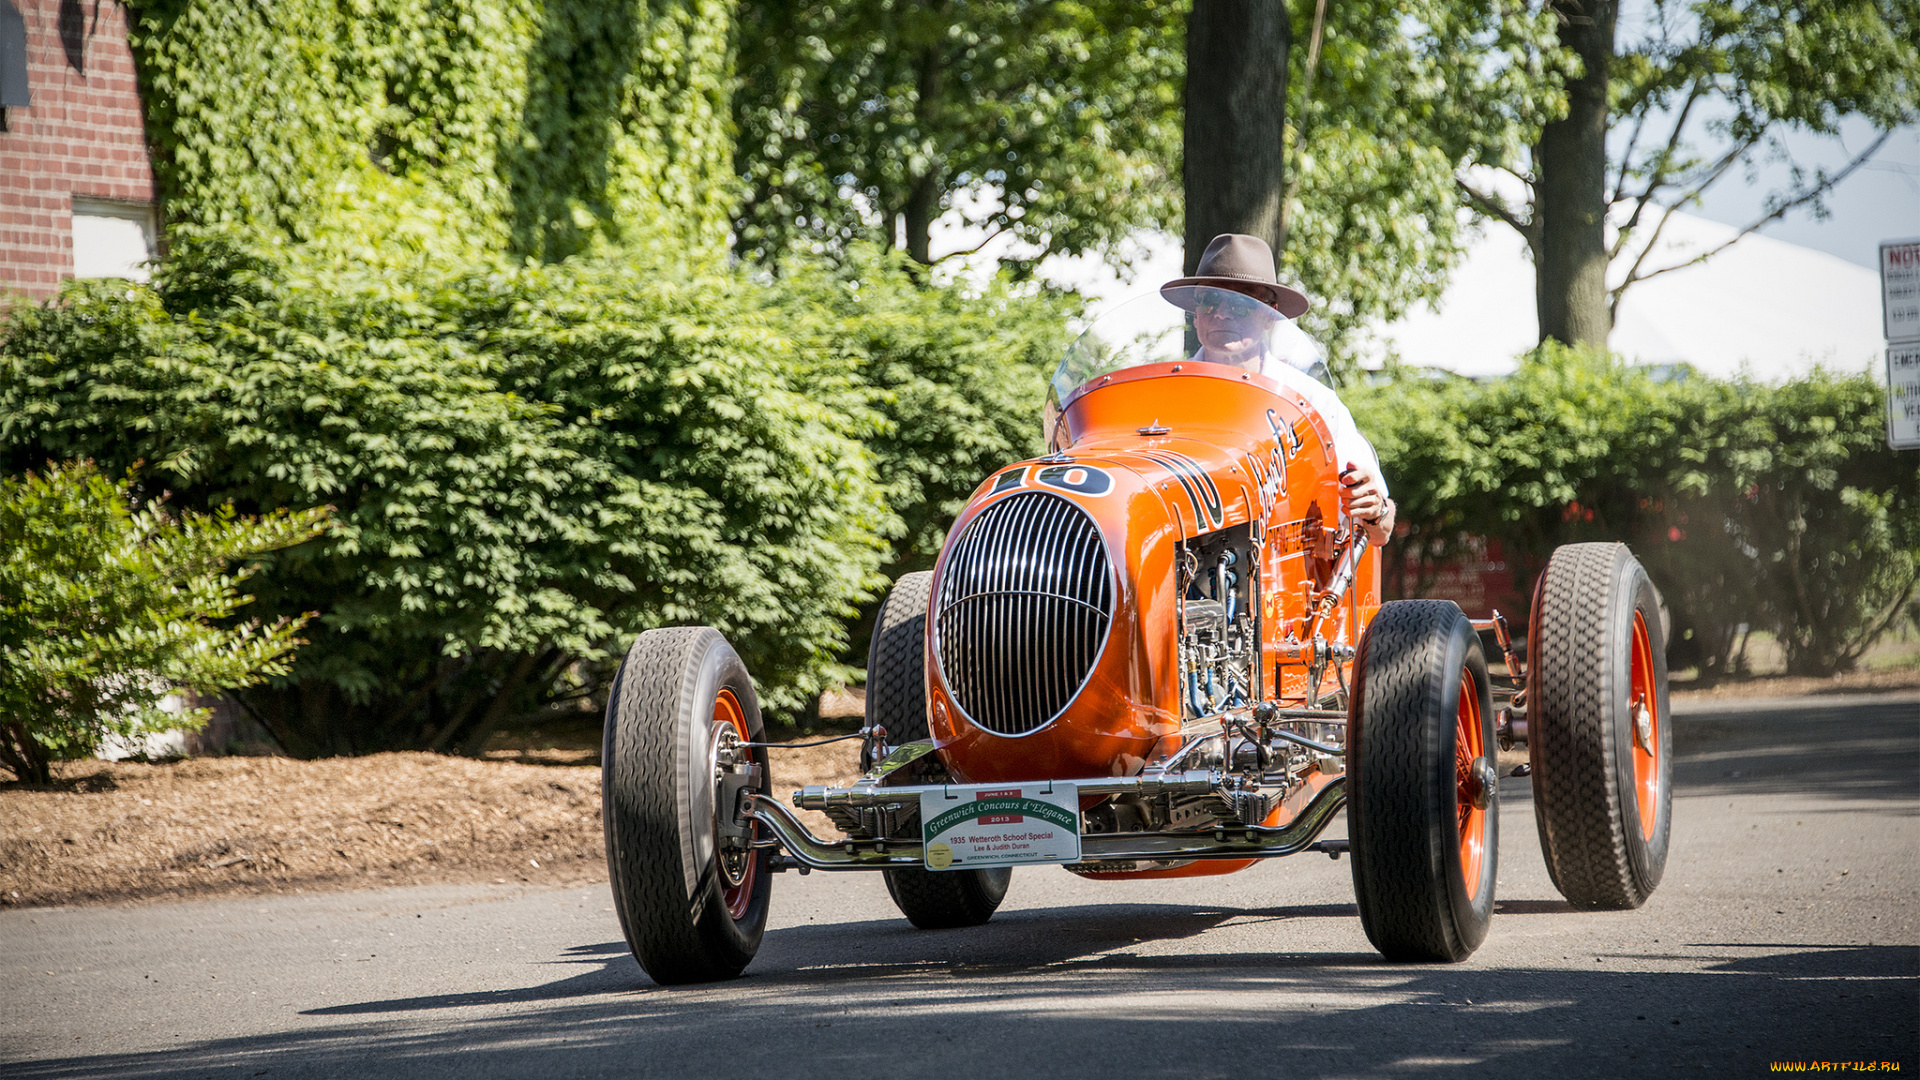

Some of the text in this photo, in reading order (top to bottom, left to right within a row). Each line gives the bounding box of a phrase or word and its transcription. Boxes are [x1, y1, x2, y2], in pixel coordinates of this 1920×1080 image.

[973, 464, 1116, 508] 10
[929, 803, 975, 834] Greenwich
[977, 802, 1020, 812] Concours
[968, 835, 1002, 844] Wetteroth
[1003, 833, 1027, 842] Schoof
[1028, 831, 1053, 842] Special
